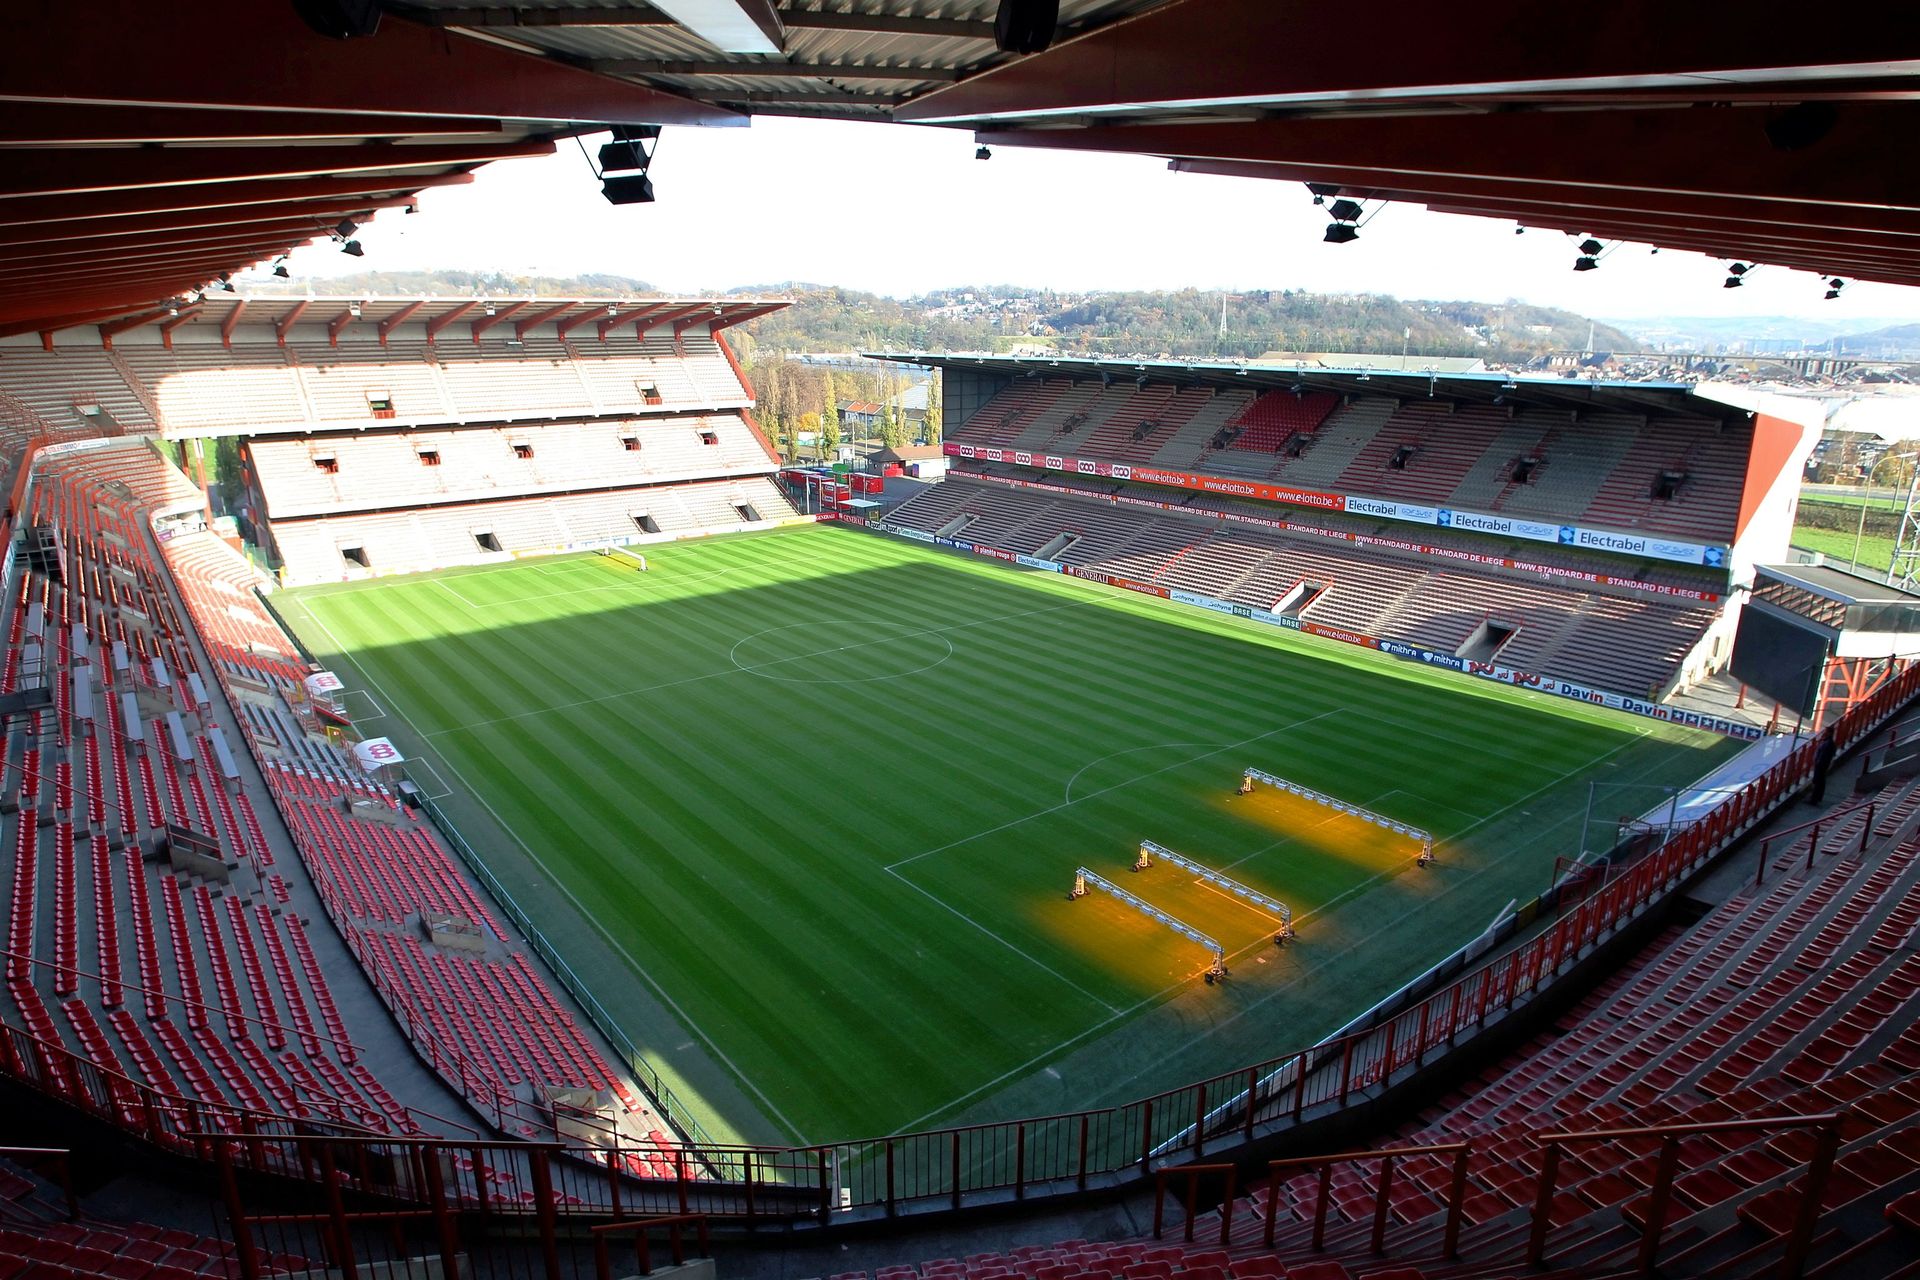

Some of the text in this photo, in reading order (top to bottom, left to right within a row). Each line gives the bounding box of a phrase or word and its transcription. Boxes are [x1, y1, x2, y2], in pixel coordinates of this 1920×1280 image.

[1140, 472, 1185, 485] www.e-lotto.be
[1204, 481, 1254, 495] www.e-lotto.be
[1276, 491, 1332, 506] www.e-lotto.be
[1348, 500, 1396, 515] Electrabel
[1286, 524, 1318, 535] STANDARD
[1329, 531, 1347, 539] LIEGE
[1456, 515, 1511, 532] Electrabel
[1355, 534, 1421, 552] WWW.STANDARD.BE
[1580, 532, 1645, 552] Electrabel
[1430, 547, 1504, 566] STANDARD DE LIEGE
[1076, 568, 1108, 584] GENERALI
[1514, 561, 1596, 582] WWW.STANDARD.BE
[1607, 577, 1701, 599] STANDARD DE LIEGE
[1233, 606, 1250, 617] BASE
[1282, 618, 1299, 628] BASE
[1316, 626, 1361, 644] www.e-lotto.be
[1391, 644, 1417, 657] mithra
[1434, 654, 1460, 667] mithra
[1561, 684, 1603, 703] Davin
[1622, 699, 1667, 719] Davin
